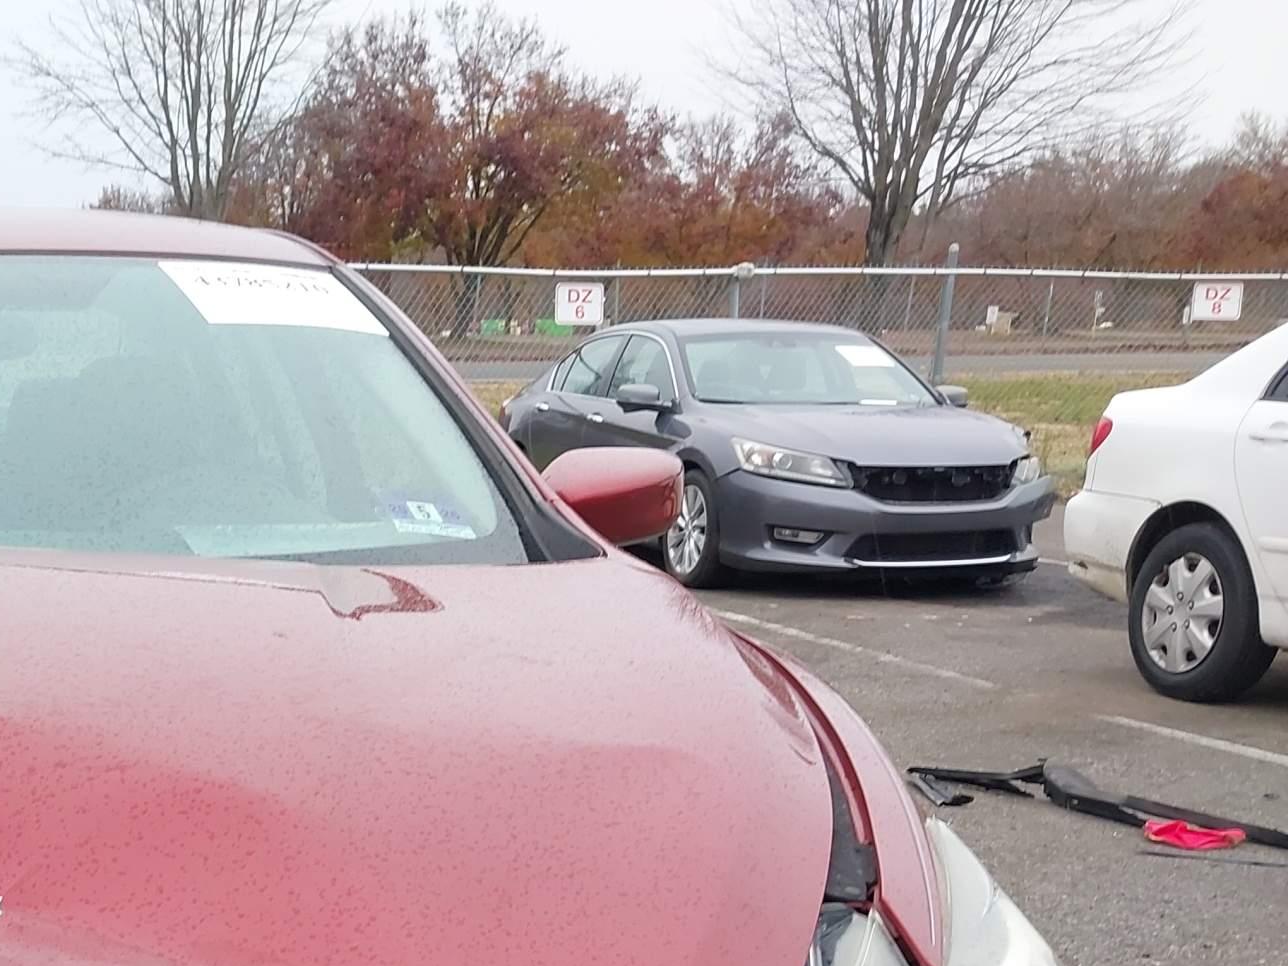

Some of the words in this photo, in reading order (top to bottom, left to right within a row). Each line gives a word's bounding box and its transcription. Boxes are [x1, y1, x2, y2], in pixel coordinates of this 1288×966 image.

[567, 288, 593, 303] DZ
[1205, 287, 1232, 300] DZ
[575, 304, 585, 319] 6
[1211, 302, 1222, 315] 8
